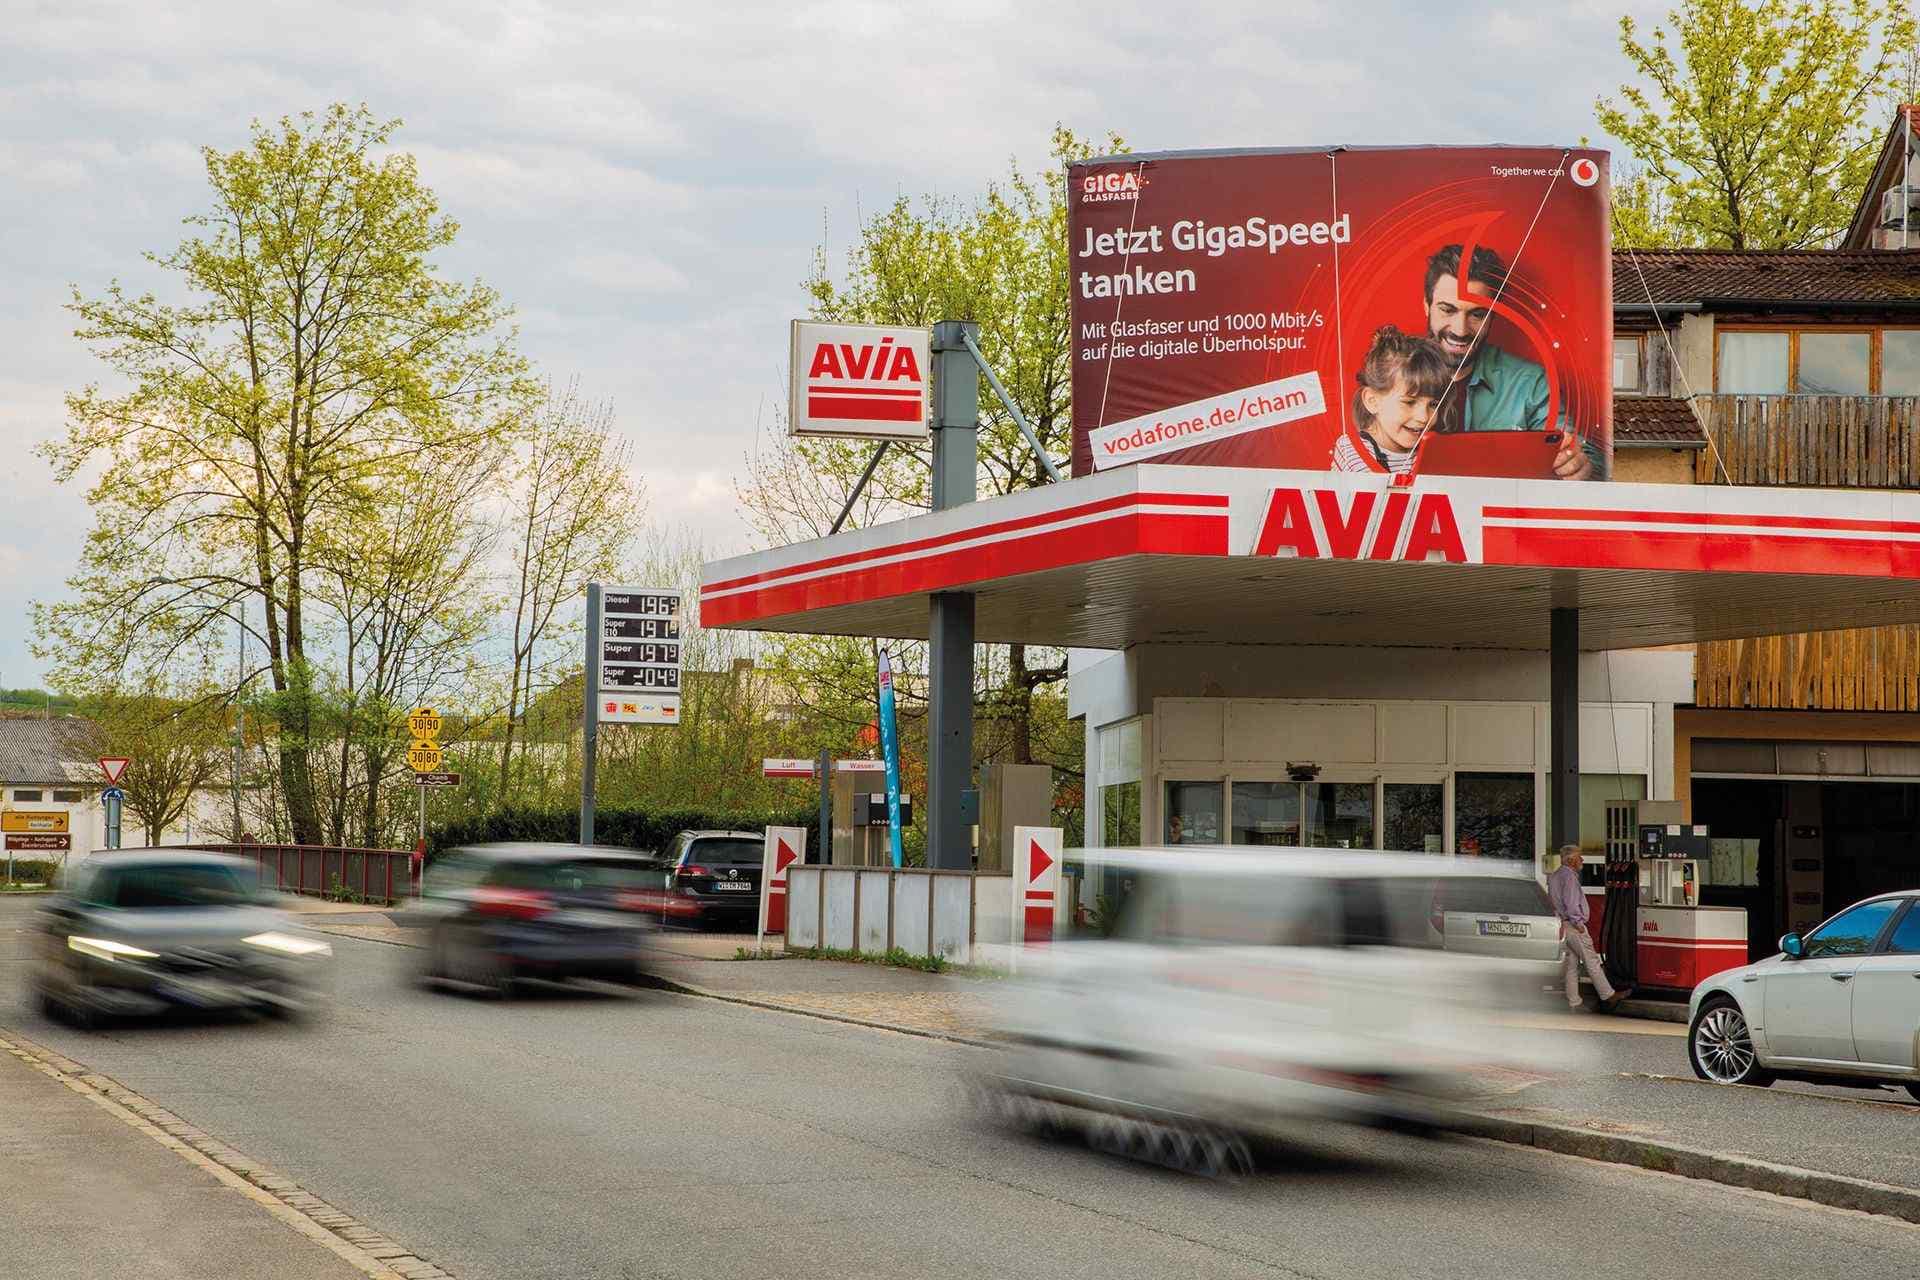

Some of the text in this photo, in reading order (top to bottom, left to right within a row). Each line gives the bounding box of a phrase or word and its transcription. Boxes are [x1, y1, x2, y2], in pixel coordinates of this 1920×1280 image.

[1491, 166, 1531, 177] Together
[1548, 168, 1565, 177] can
[1083, 172, 1137, 193] GIGA
[1082, 192, 1139, 203] GLASFASER
[1079, 213, 1351, 258] Jetzt GigaSpeed
[1079, 265, 1197, 299] tanken
[1082, 310, 1323, 340] Mit Glasfaser und 1000 Mbit/s
[1082, 333, 1306, 361] auf die digitale Überholspur.
[808, 336, 922, 382] AVIA
[1104, 388, 1307, 455] vodafone.de/cham
[1255, 473, 1469, 562] AVIA
[605, 595, 630, 604] Diesel
[605, 618, 626, 628] Super
[604, 643, 632, 654] Super
[604, 667, 625, 677] Super
[412, 719, 438, 730] 30 90
[412, 752, 438, 763] 30 80
[782, 761, 796, 769] Luft
[1642, 919, 1659, 932] AVIA
